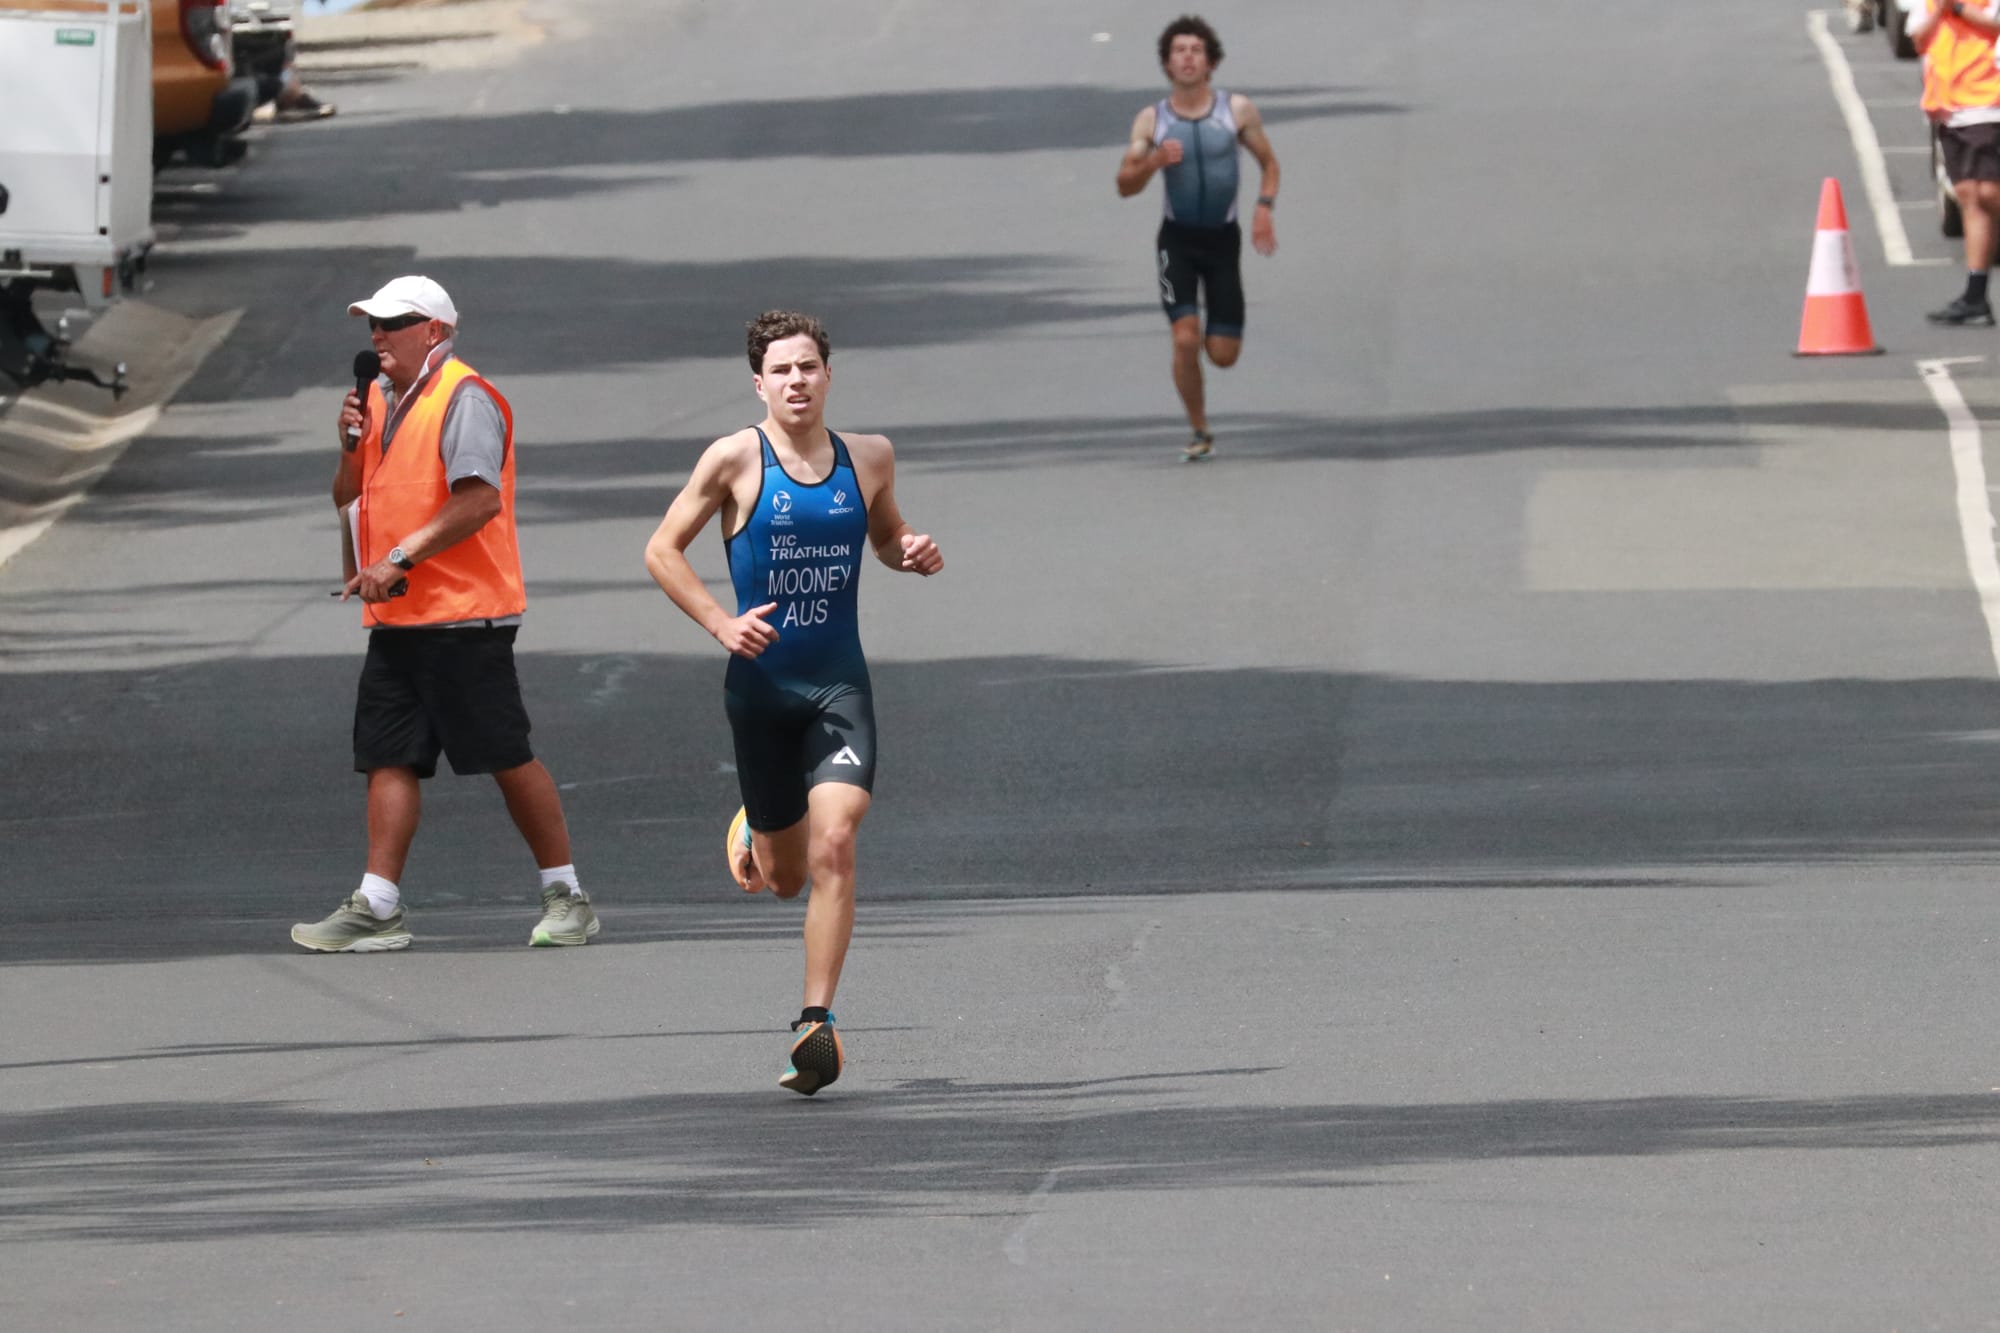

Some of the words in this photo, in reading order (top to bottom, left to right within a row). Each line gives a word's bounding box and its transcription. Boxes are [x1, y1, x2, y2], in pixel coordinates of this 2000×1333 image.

[770, 544, 850, 560] TRIATHLON
[771, 534, 797, 547] VIC
[768, 564, 851, 596] MOONEY
[782, 598, 829, 628] AUS
